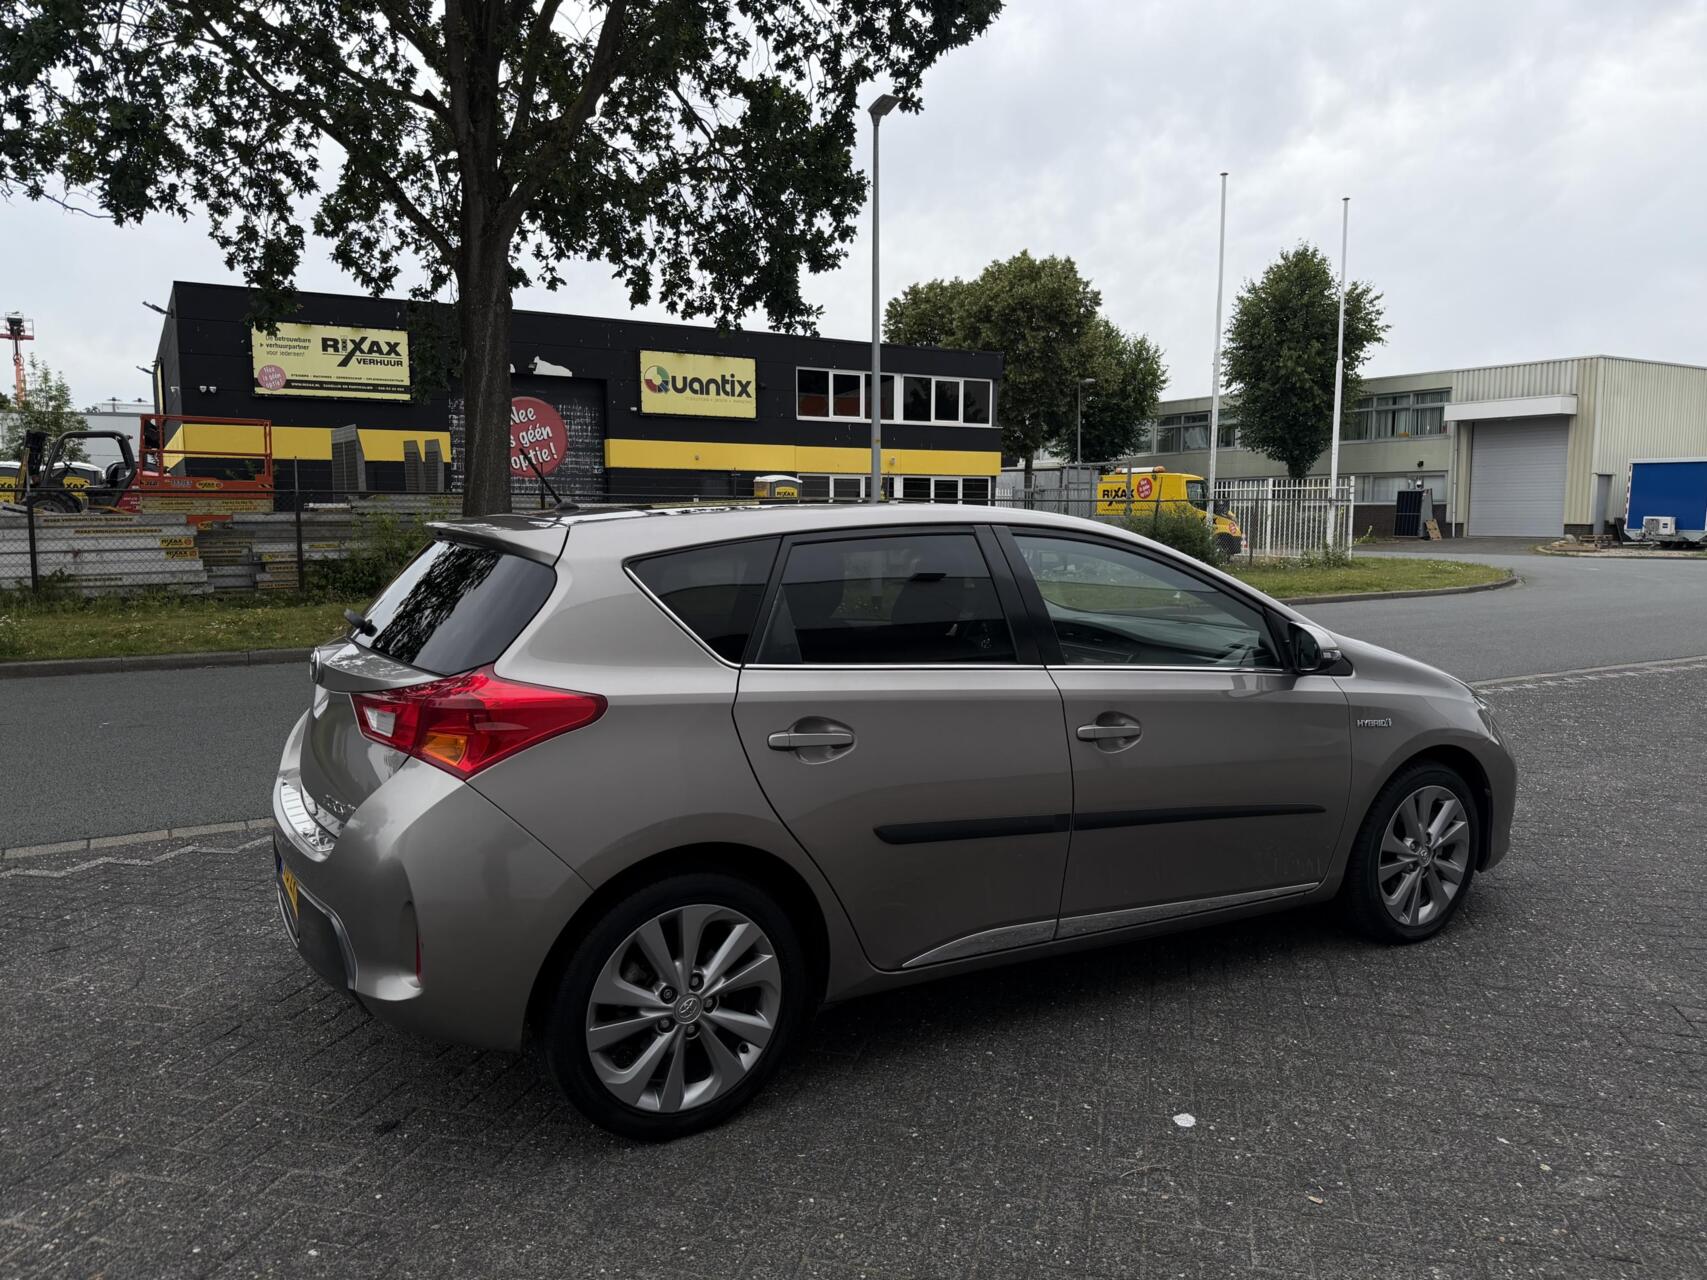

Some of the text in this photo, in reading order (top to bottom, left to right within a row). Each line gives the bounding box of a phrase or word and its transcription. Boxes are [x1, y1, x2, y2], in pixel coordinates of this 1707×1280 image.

[265, 342, 310, 351] verhuurpartner
[275, 335, 312, 344] betrouwbare
[321, 336, 402, 368] RIXAX
[355, 357, 404, 367] VERHUUR
[643, 364, 752, 399] Quantix
[510, 406, 537, 426] Nee
[518, 423, 553, 448] géén
[510, 442, 558, 471] optie!
[1356, 718, 1388, 728] HYBRID
